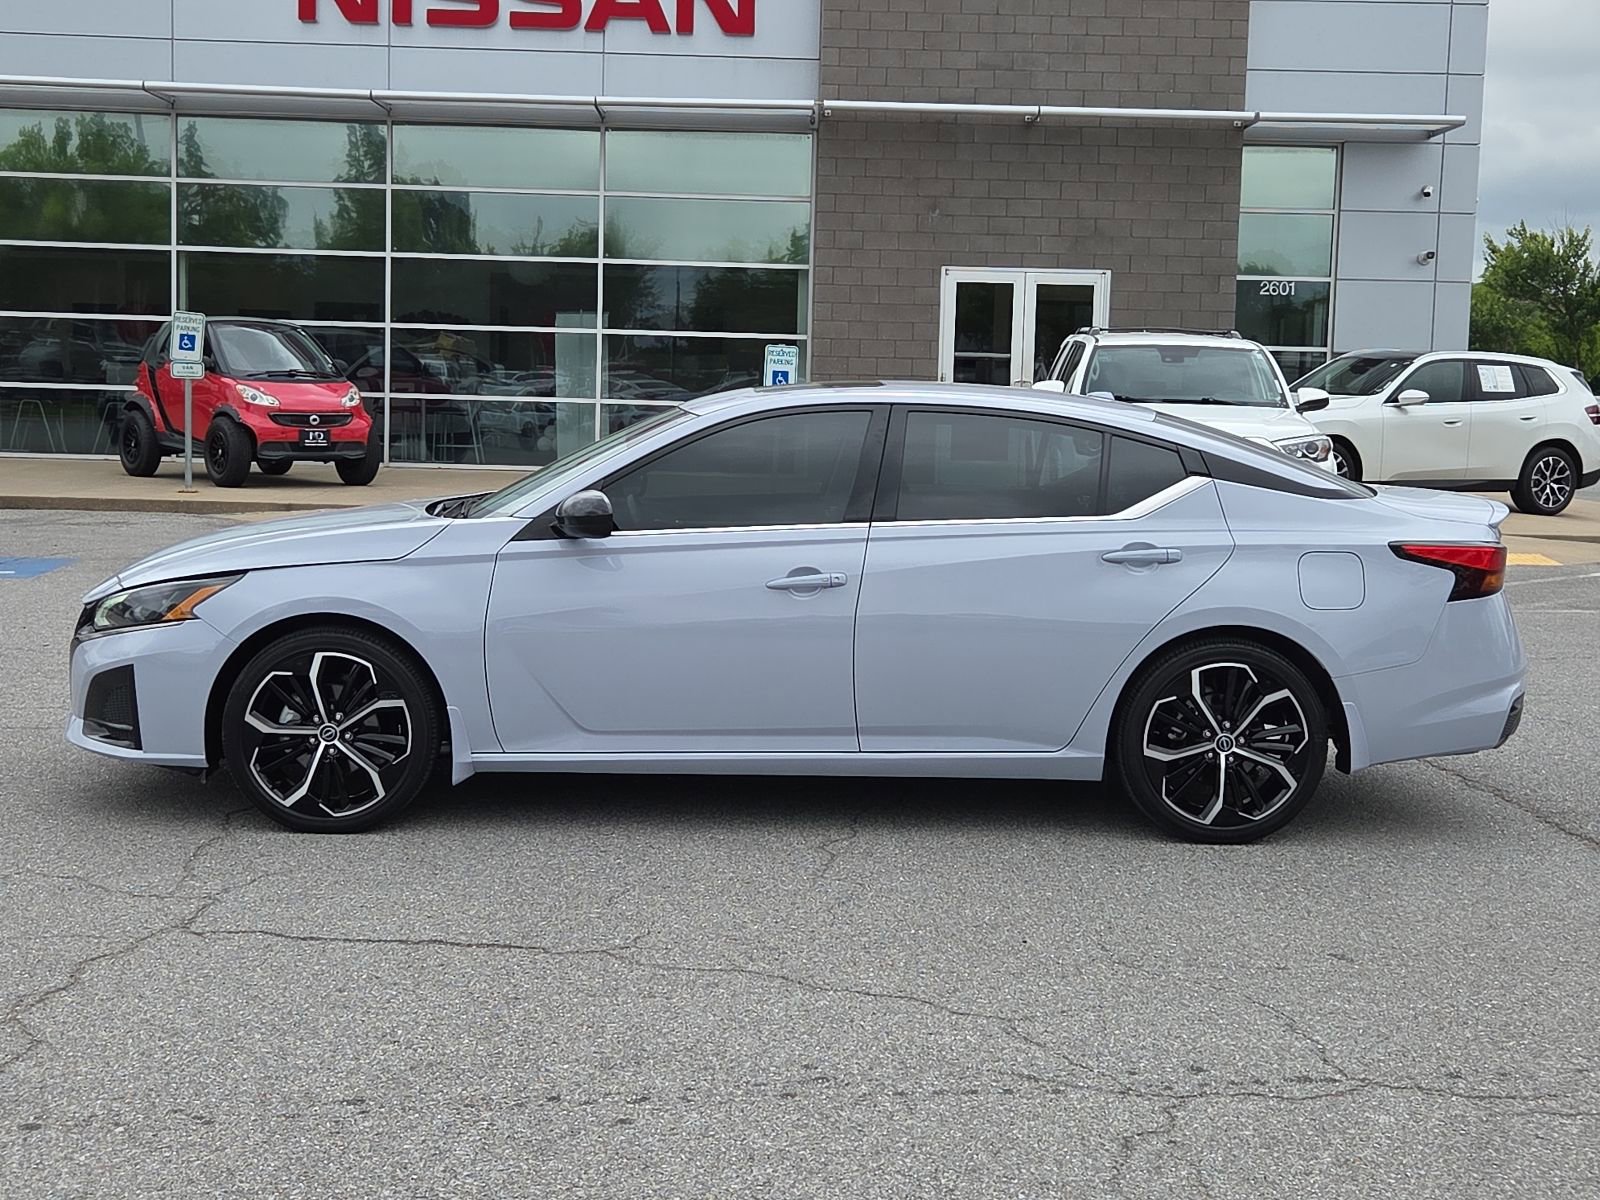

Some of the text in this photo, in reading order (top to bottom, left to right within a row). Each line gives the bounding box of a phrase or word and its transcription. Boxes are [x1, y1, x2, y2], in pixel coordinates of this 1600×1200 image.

[1259, 280, 1296, 296] 2601
[175, 324, 201, 333] PARKING
[768, 357, 794, 366] PARKING
